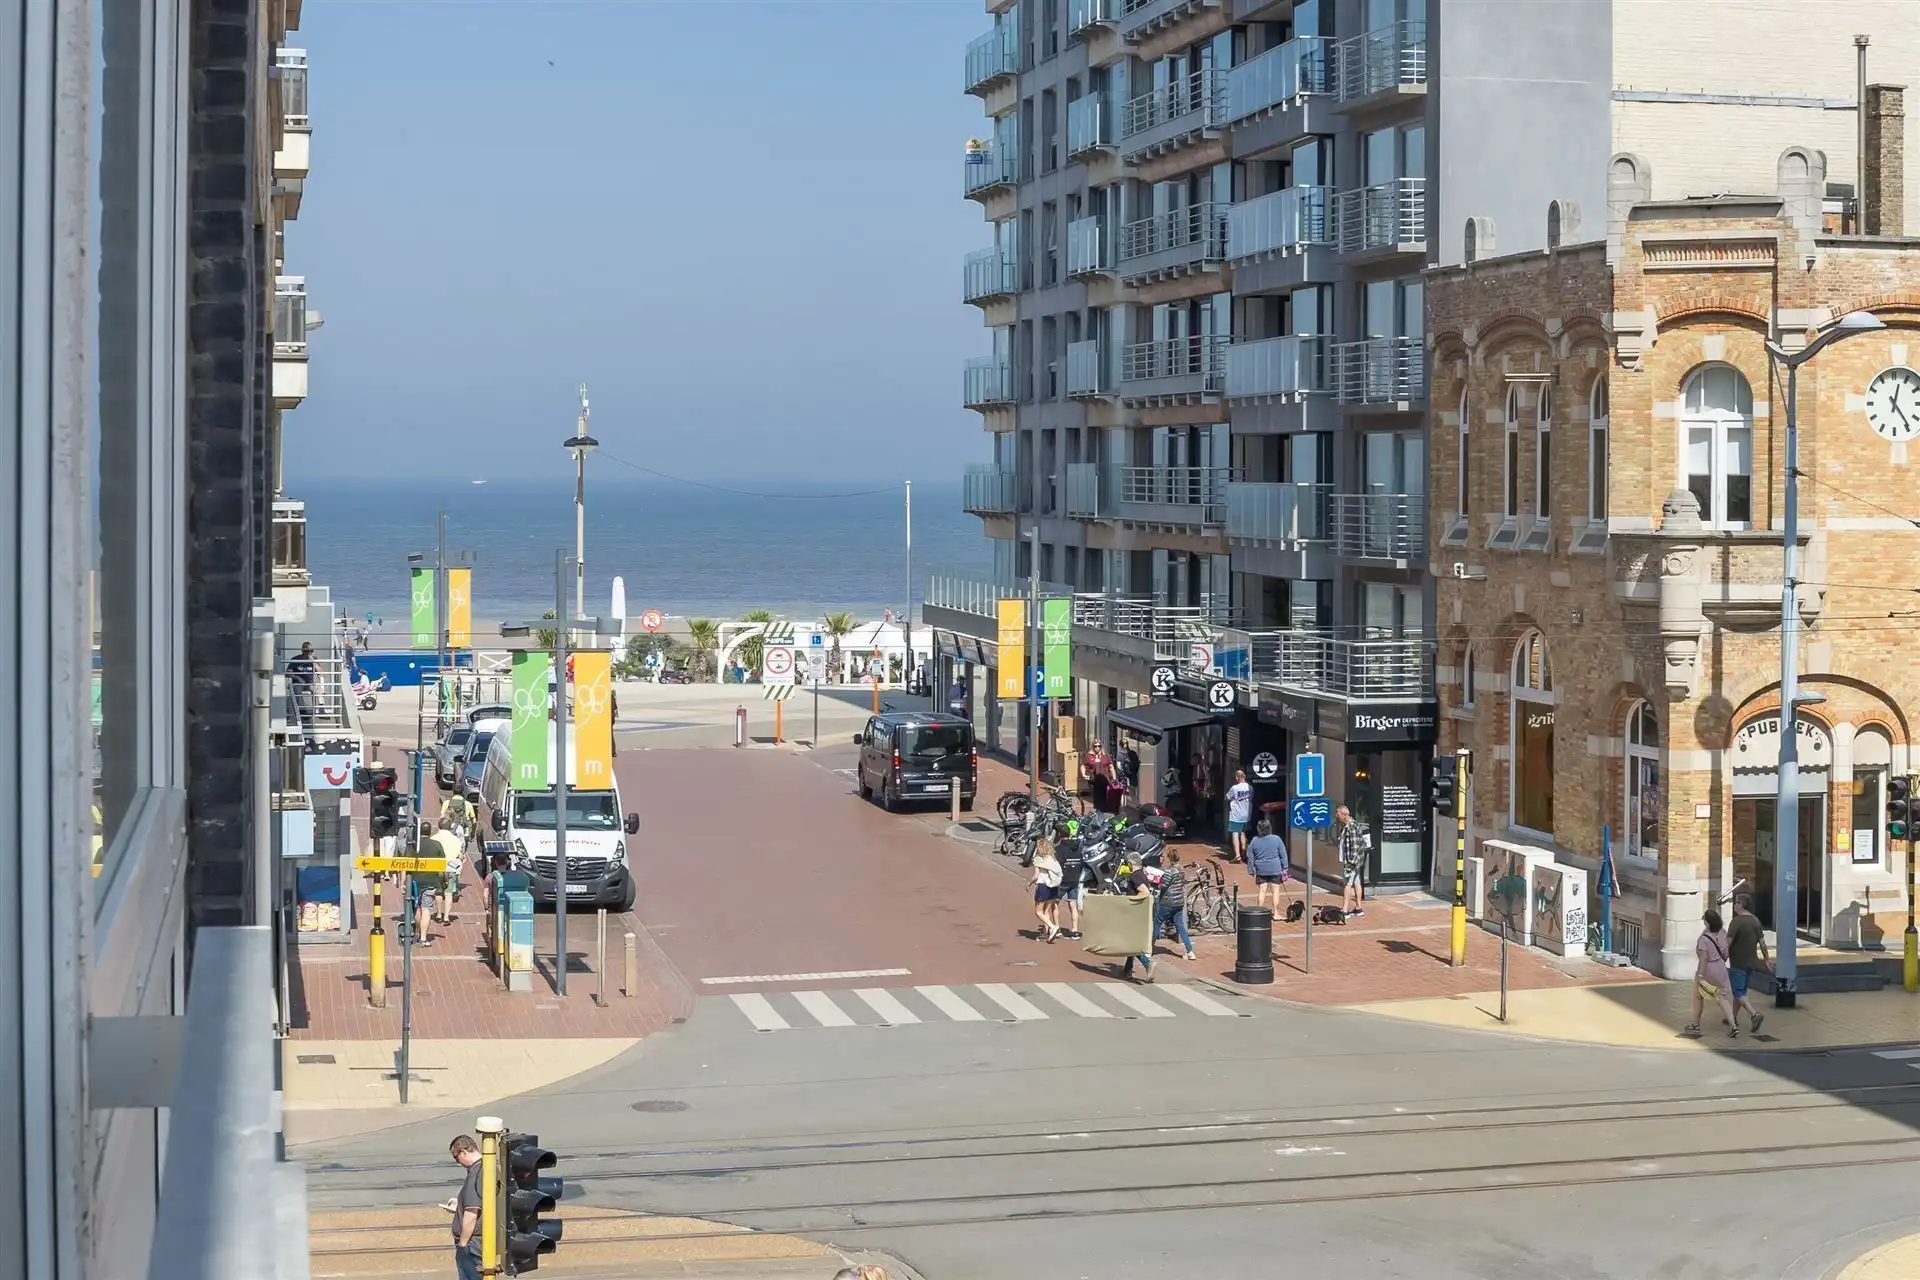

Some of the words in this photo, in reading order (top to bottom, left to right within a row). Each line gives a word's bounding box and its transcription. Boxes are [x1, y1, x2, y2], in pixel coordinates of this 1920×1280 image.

[1214, 689, 1230, 704] K
[1746, 720, 1815, 739] PUBEK
[521, 763, 539, 779] m
[584, 759, 603, 776] m
